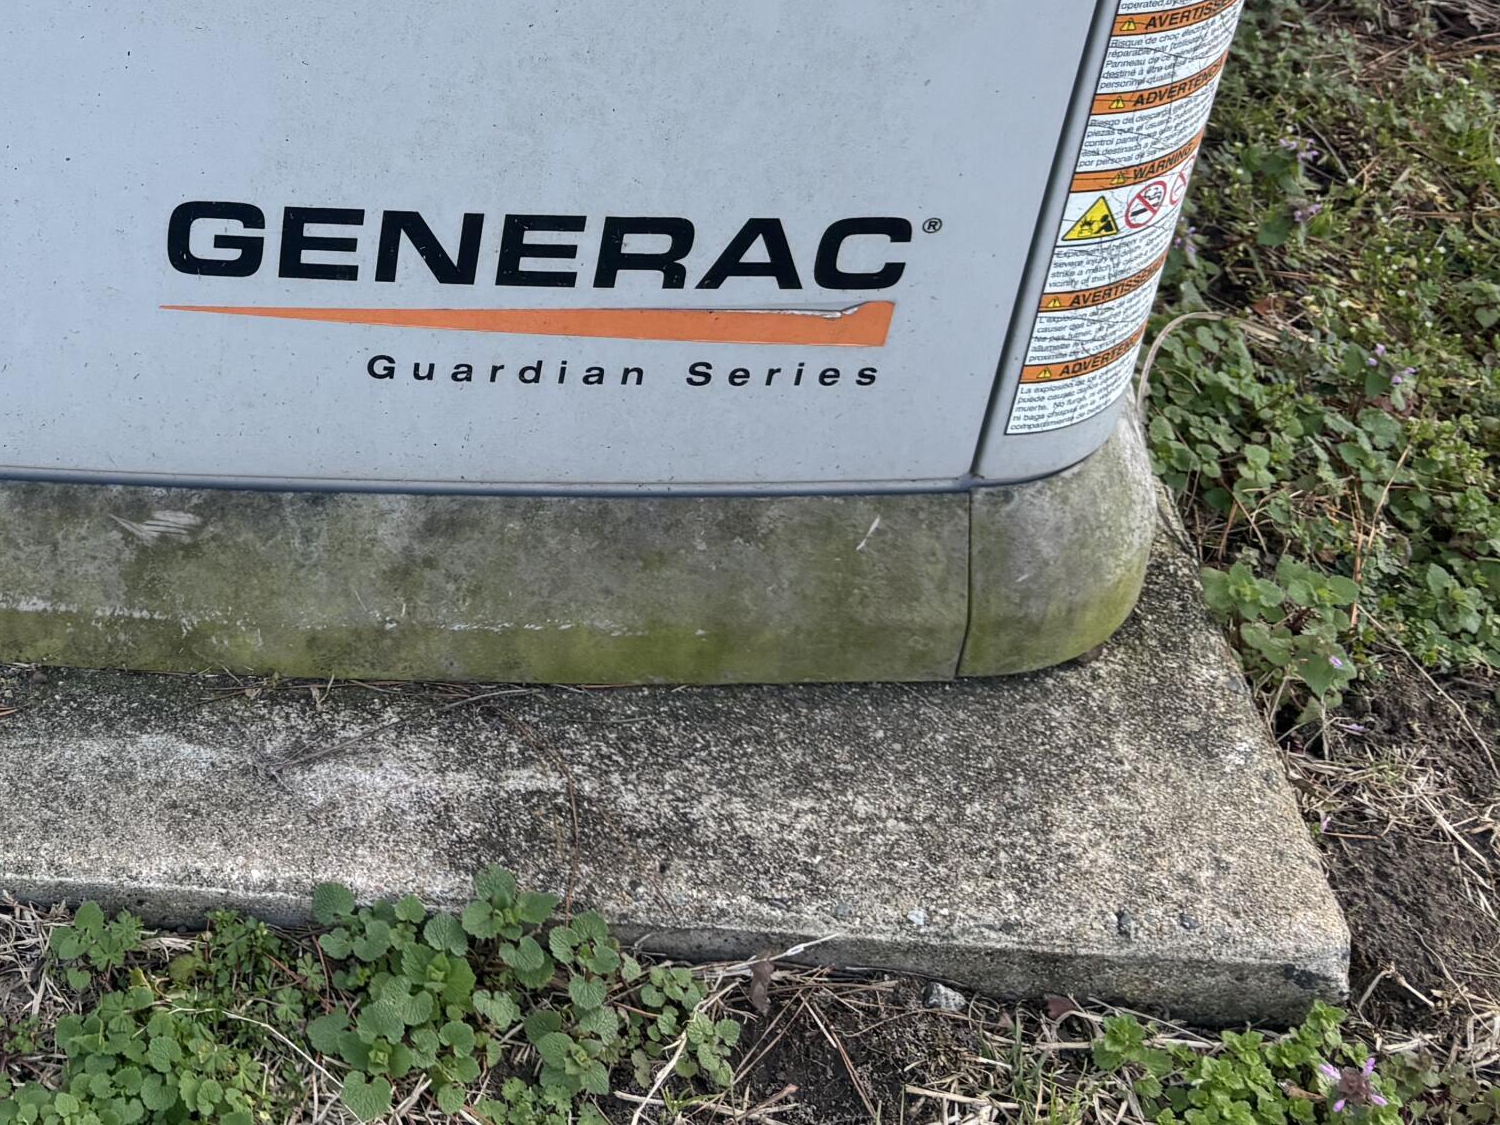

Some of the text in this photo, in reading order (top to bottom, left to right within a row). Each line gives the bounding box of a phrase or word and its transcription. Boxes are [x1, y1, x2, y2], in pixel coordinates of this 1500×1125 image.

[1121, 0, 1164, 10] operated
[1131, 143, 1194, 181] WARNING
[366, 354, 879, 387] Guardian Series
